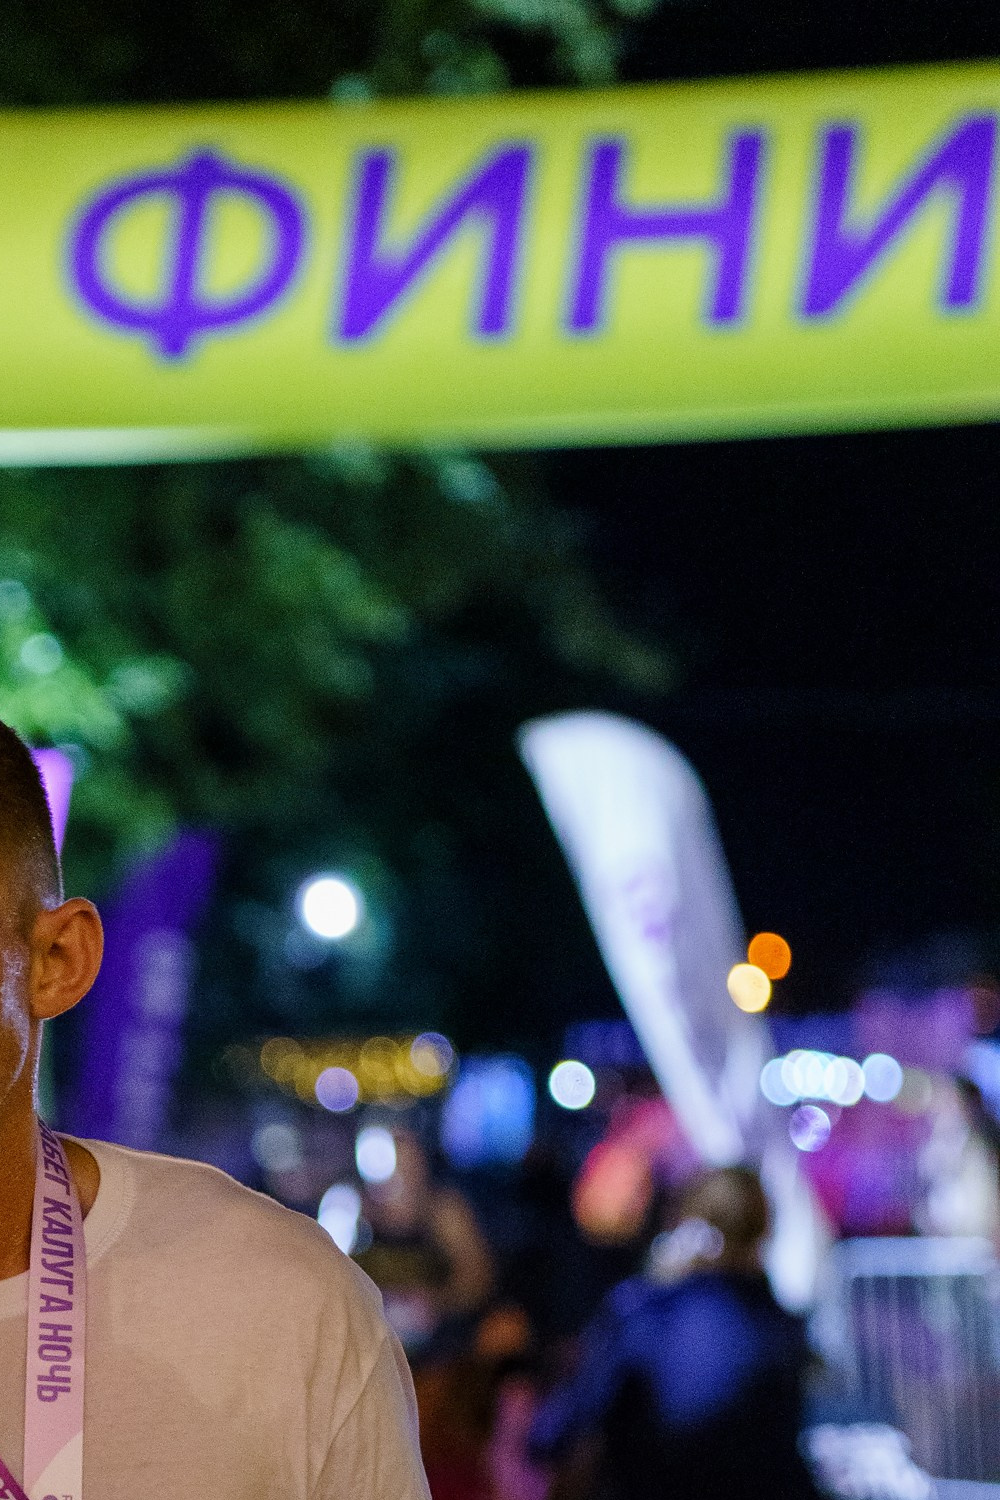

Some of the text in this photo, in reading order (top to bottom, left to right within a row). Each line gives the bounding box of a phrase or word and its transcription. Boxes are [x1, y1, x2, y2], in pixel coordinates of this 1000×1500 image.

[66, 109, 1000, 360] ФИНИ
[40, 1196, 73, 1313] КАЛУГА
[37, 1322, 73, 1403] НОЧЬ
